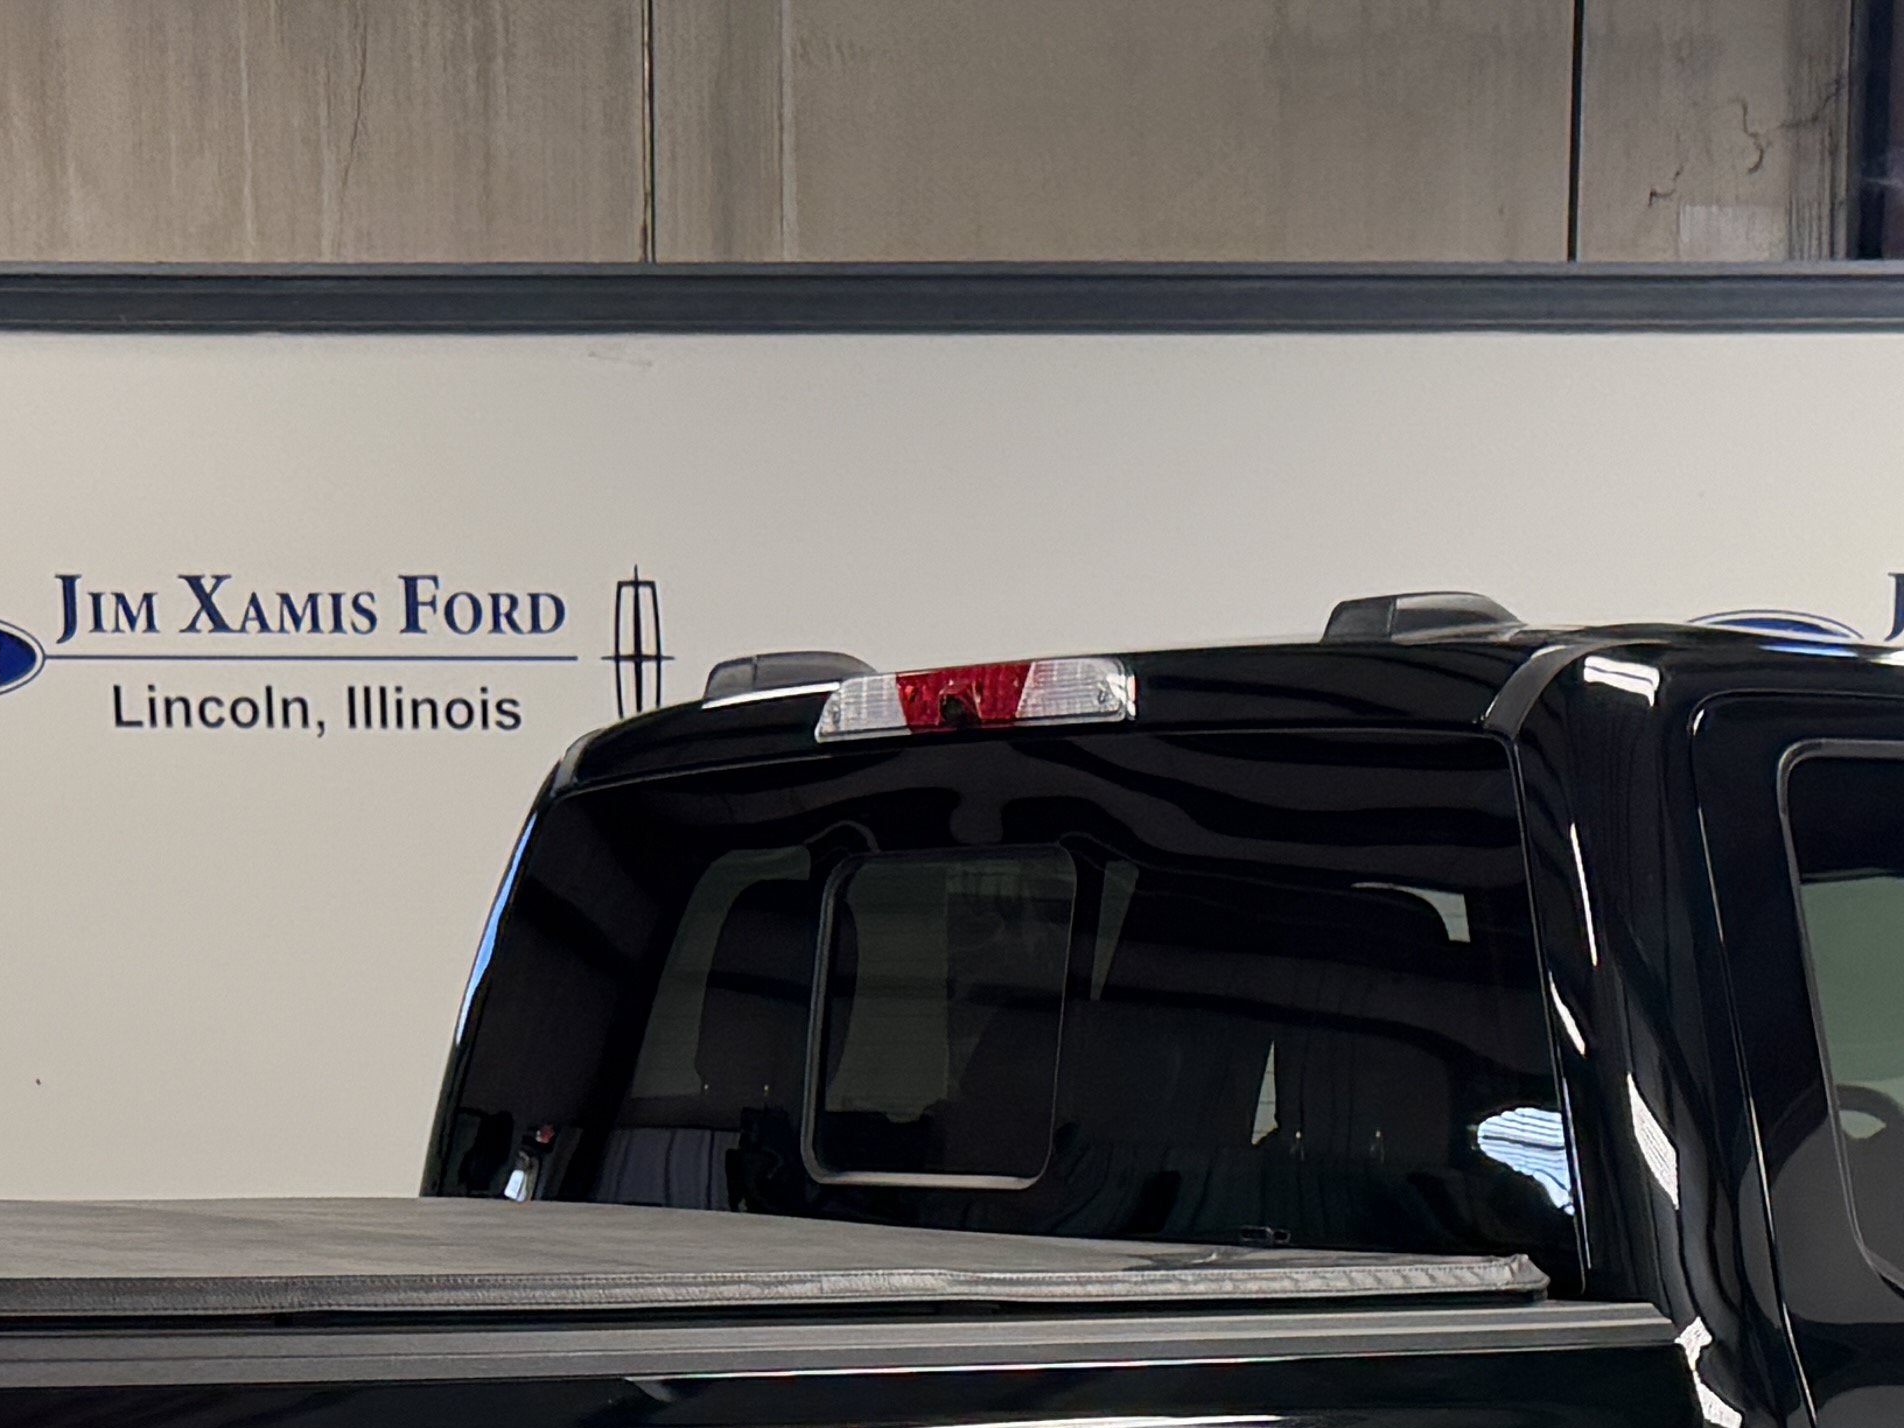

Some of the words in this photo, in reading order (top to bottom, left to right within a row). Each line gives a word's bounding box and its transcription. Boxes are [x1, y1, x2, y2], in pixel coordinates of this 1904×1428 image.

[55, 574, 159, 644] JIM
[179, 574, 377, 635] XAMIS
[399, 574, 566, 634] FORD
[114, 685, 325, 737] Lincoln,
[347, 685, 521, 731] Illinois
